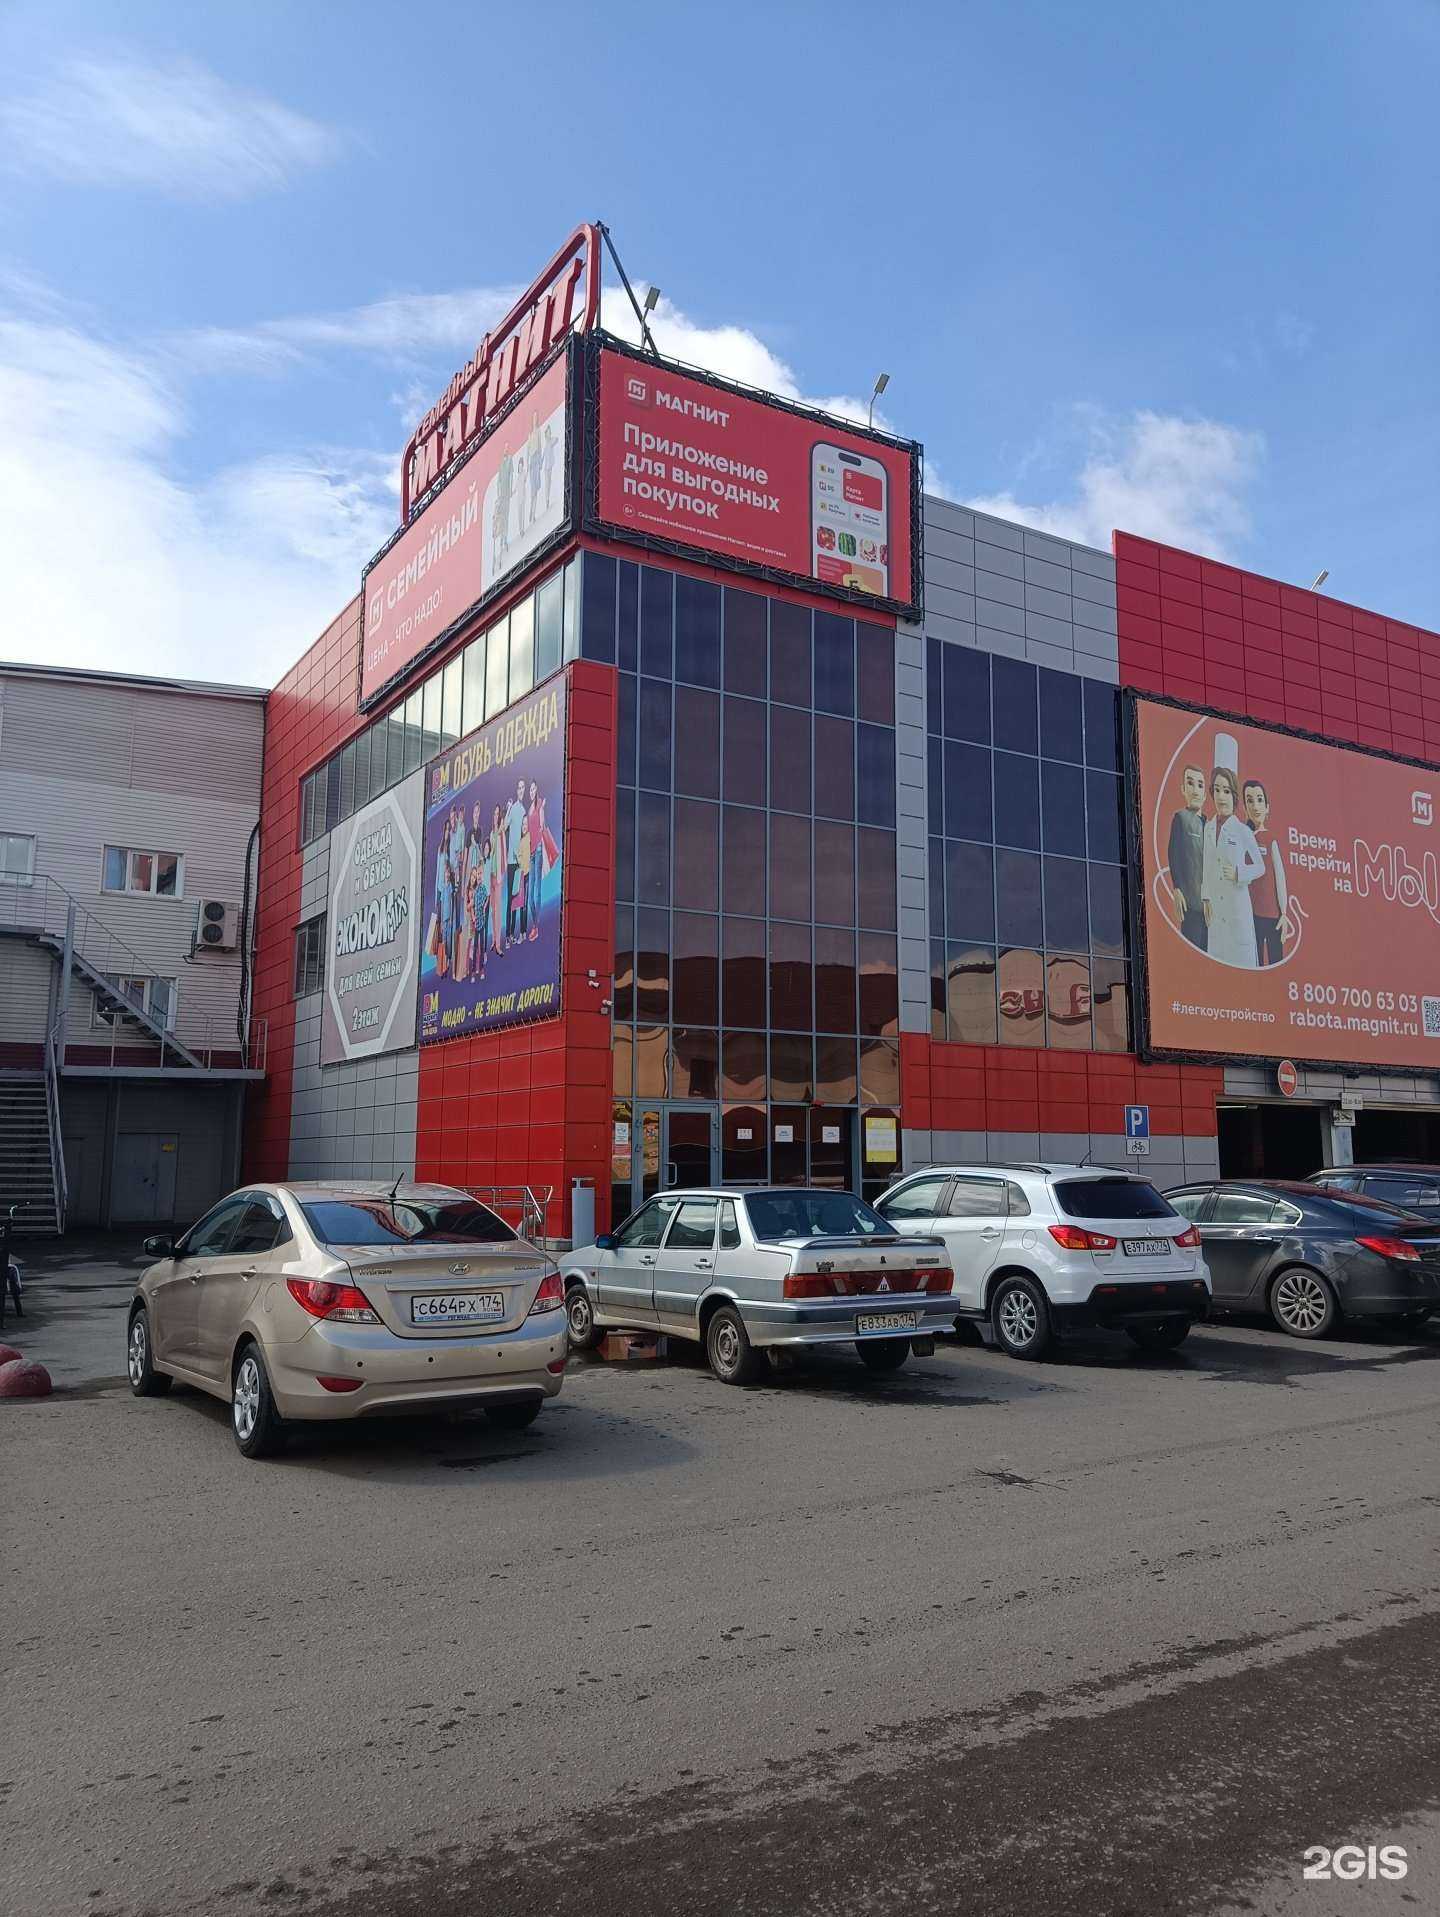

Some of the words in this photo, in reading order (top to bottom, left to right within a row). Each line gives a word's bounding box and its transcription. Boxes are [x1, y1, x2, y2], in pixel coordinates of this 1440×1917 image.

[410, 258, 583, 504] МАГНИТ
[416, 333, 491, 444] СЕМЕЙНЫЙ
[655, 390, 730, 428] МАГНИТ
[624, 422, 768, 485] Приложение
[623, 453, 666, 479] для
[672, 467, 780, 513] выгодных
[623, 477, 719, 519] покупок
[386, 480, 478, 609] СЕМЕЙНЫЙ
[367, 640, 389, 672] ЦЕНА
[395, 619, 412, 644] ЧТО
[414, 585, 443, 627] НАДО!
[453, 737, 491, 791] ОБУВЬ
[495, 691, 557, 768] ОДЕЖДА
[354, 823, 392, 866] ОДЕЖДА
[1288, 827, 1336, 852] Время
[363, 855, 392, 891] ОБУВЬ
[1290, 851, 1351, 875] перейти
[1334, 878, 1353, 893] на
[441, 1006, 466, 1028] МОДНО
[475, 1001, 484, 1019] НЕ
[486, 991, 517, 1017] ЗНАЧИТ
[517, 983, 554, 1013] ДОРОГО!
[1172, 1000, 1275, 1023] #легкоустройство
[1288, 982, 1299, 1000] 8
[1303, 983, 1337, 1004] 800
[1341, 987, 1371, 1008] 700
[1376, 992, 1394, 1010] 63
[1399, 994, 1418, 1013] 03
[1289, 1009, 1418, 1037] rabota.magnit.ru
[1131, 1109, 1143, 1136] P
